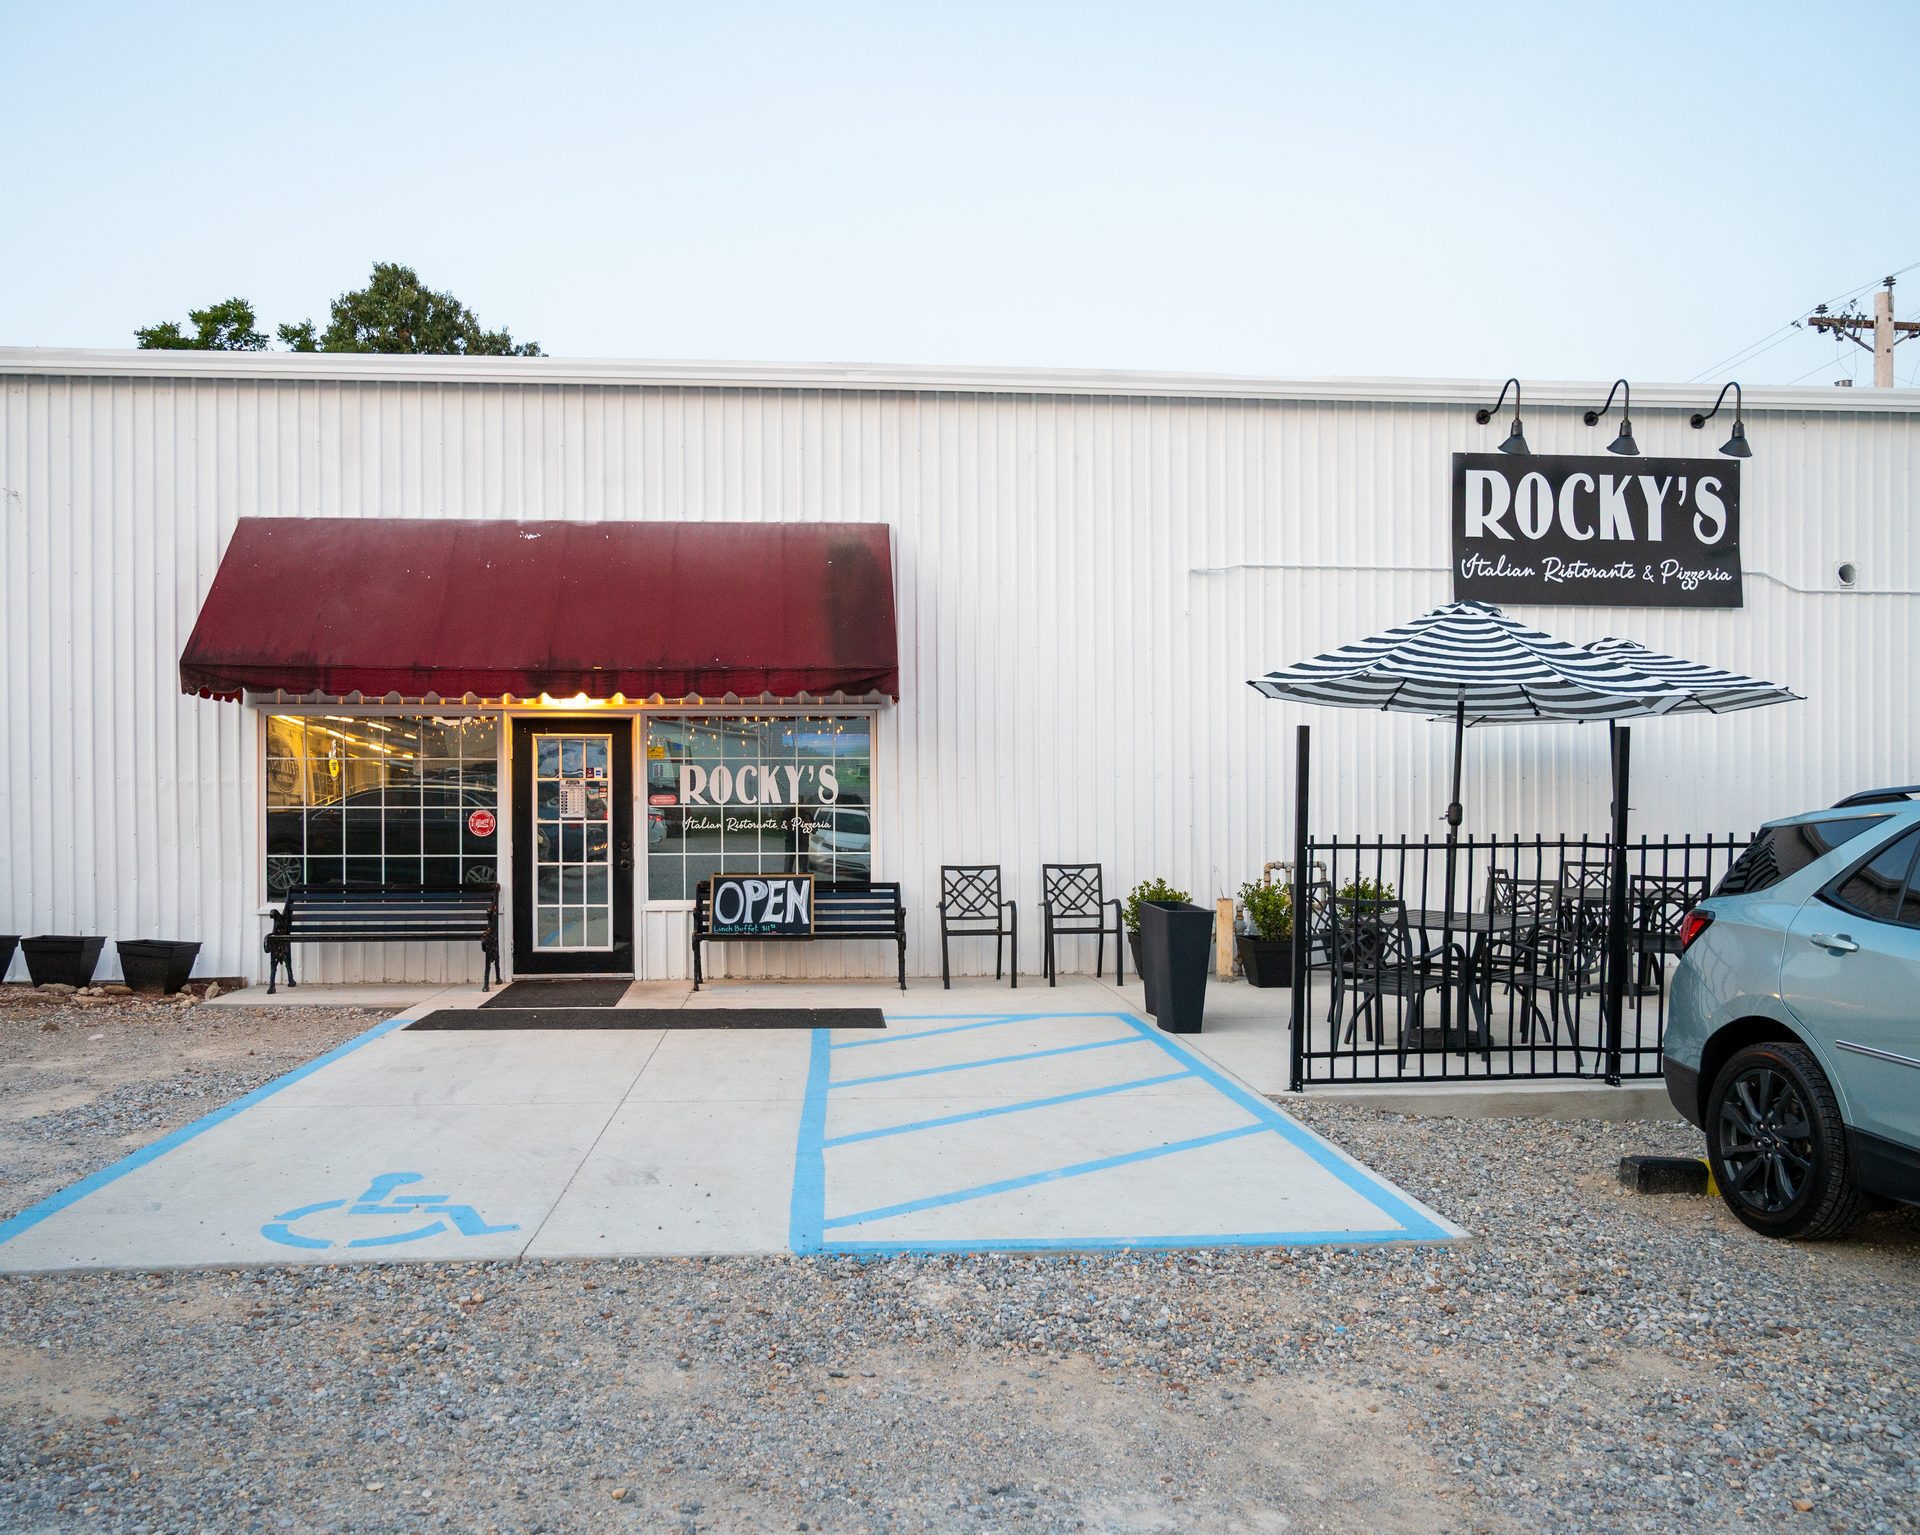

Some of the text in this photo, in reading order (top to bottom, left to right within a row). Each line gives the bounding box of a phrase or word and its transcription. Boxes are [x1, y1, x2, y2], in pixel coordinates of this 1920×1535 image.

[1464, 469, 1727, 545] ROCKY'S
[1461, 552, 1732, 591] Italian Ristorante & Pizzeria
[679, 764, 839, 805] ROCKY'S
[682, 816, 832, 834] Italian Ristorante & Pizzeria
[715, 879, 811, 924] OPEN
[734, 924, 759, 932] Buffet
